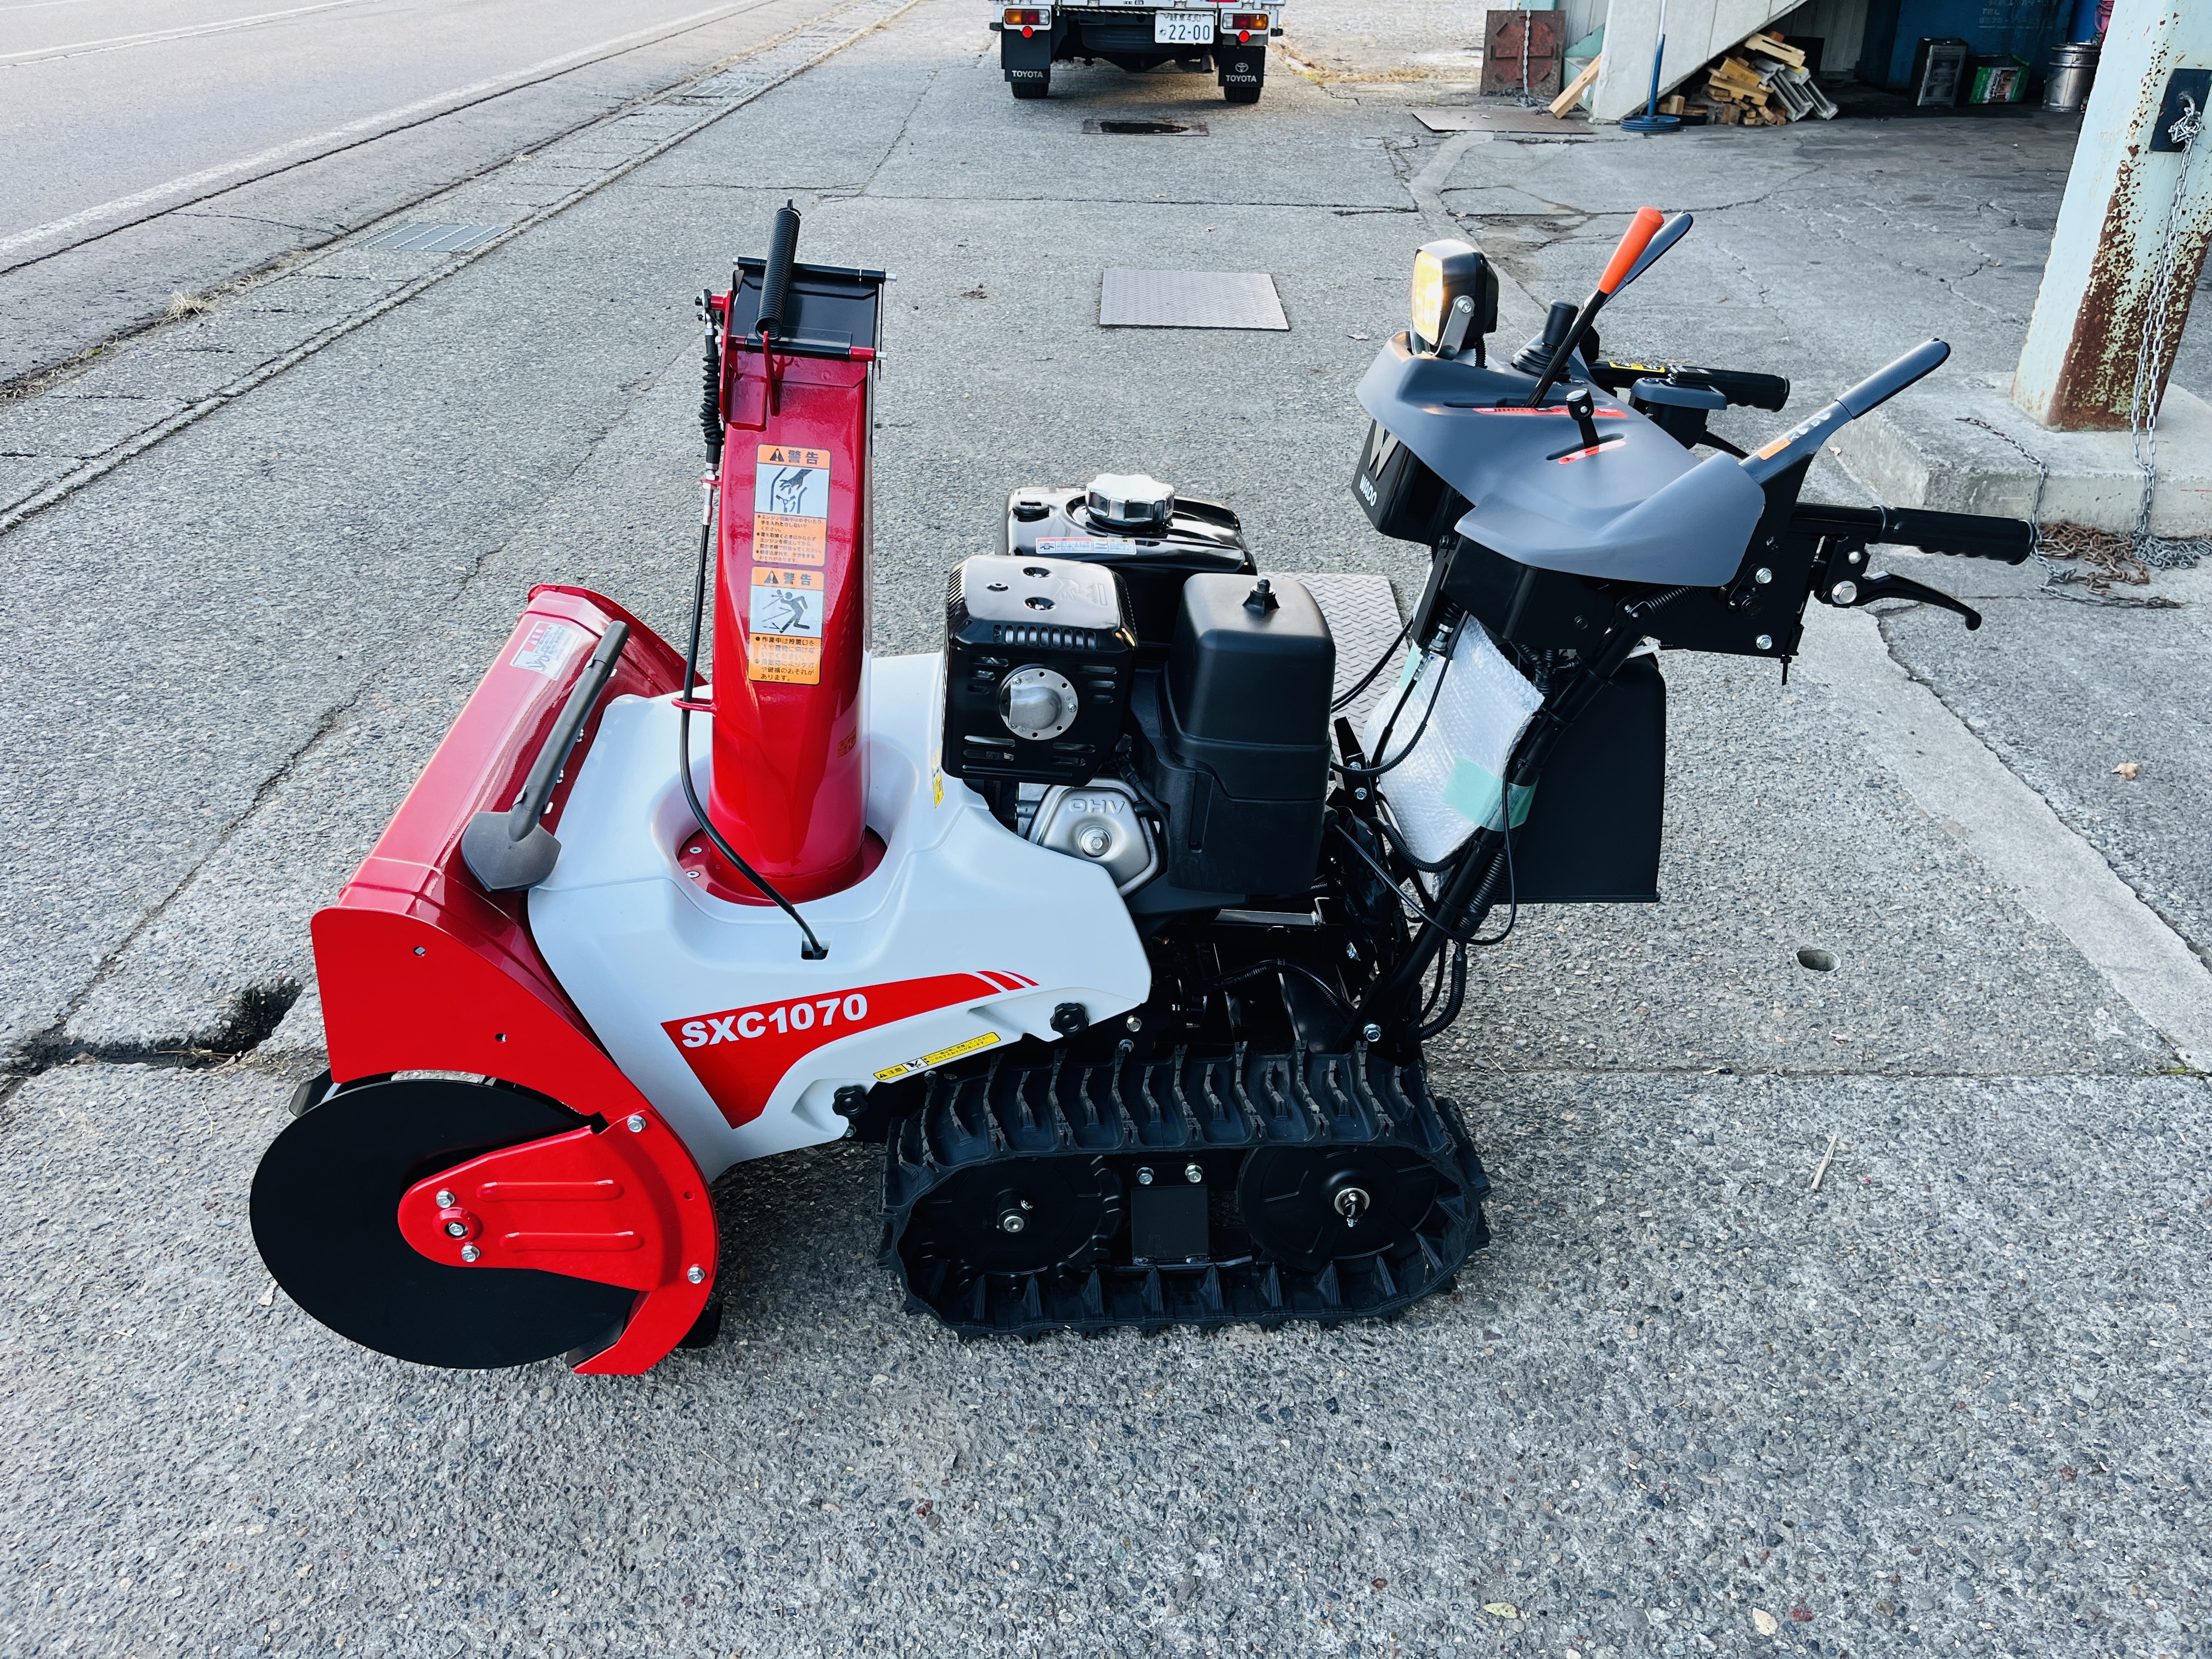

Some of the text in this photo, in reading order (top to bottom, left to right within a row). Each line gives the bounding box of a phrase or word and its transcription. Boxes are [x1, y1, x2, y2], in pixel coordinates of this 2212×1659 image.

[1169, 24, 1210, 40] 22-00
[788, 449, 819, 465] 警告
[1359, 473, 1378, 506] WADO
[783, 572, 812, 586] 警告
[1069, 799, 1125, 814] OHV
[681, 994, 867, 1048] SXC1070
